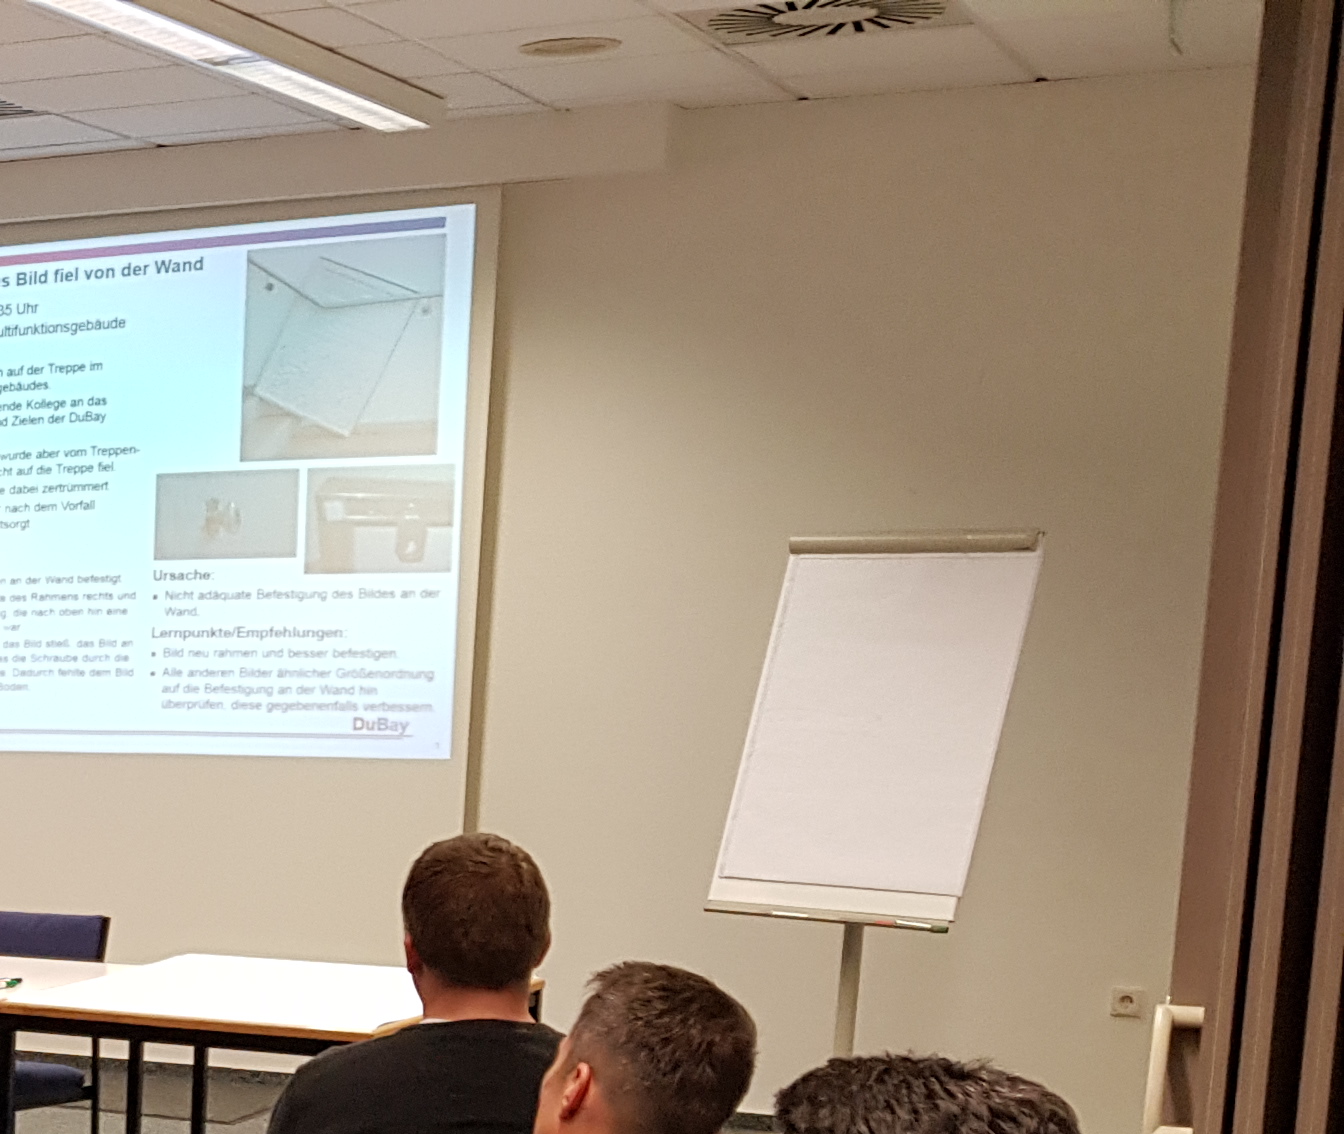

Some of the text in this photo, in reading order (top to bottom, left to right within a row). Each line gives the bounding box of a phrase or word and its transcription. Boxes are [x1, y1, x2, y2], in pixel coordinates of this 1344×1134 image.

[15, 269, 48, 286] Bild
[53, 267, 79, 282] fiel
[83, 267, 115, 280] von
[120, 261, 149, 277] der
[154, 256, 204, 274] Wand
[16, 302, 39, 314] Uhr
[6, 365, 24, 377] auf
[26, 364, 44, 375] der
[47, 360, 86, 375] Treppe
[89, 362, 103, 370] im
[25, 398, 67, 412] Kollege
[69, 398, 84, 407] an
[86, 395, 107, 406] das
[11, 414, 44, 426] Zielen
[47, 414, 65, 424] der
[68, 410, 106, 425] DuBay
[152, 568, 214, 581] Ursache:
[150, 625, 348, 642] Lernpunkte/Empfehlungen:
[350, 716, 411, 736] DuBay
